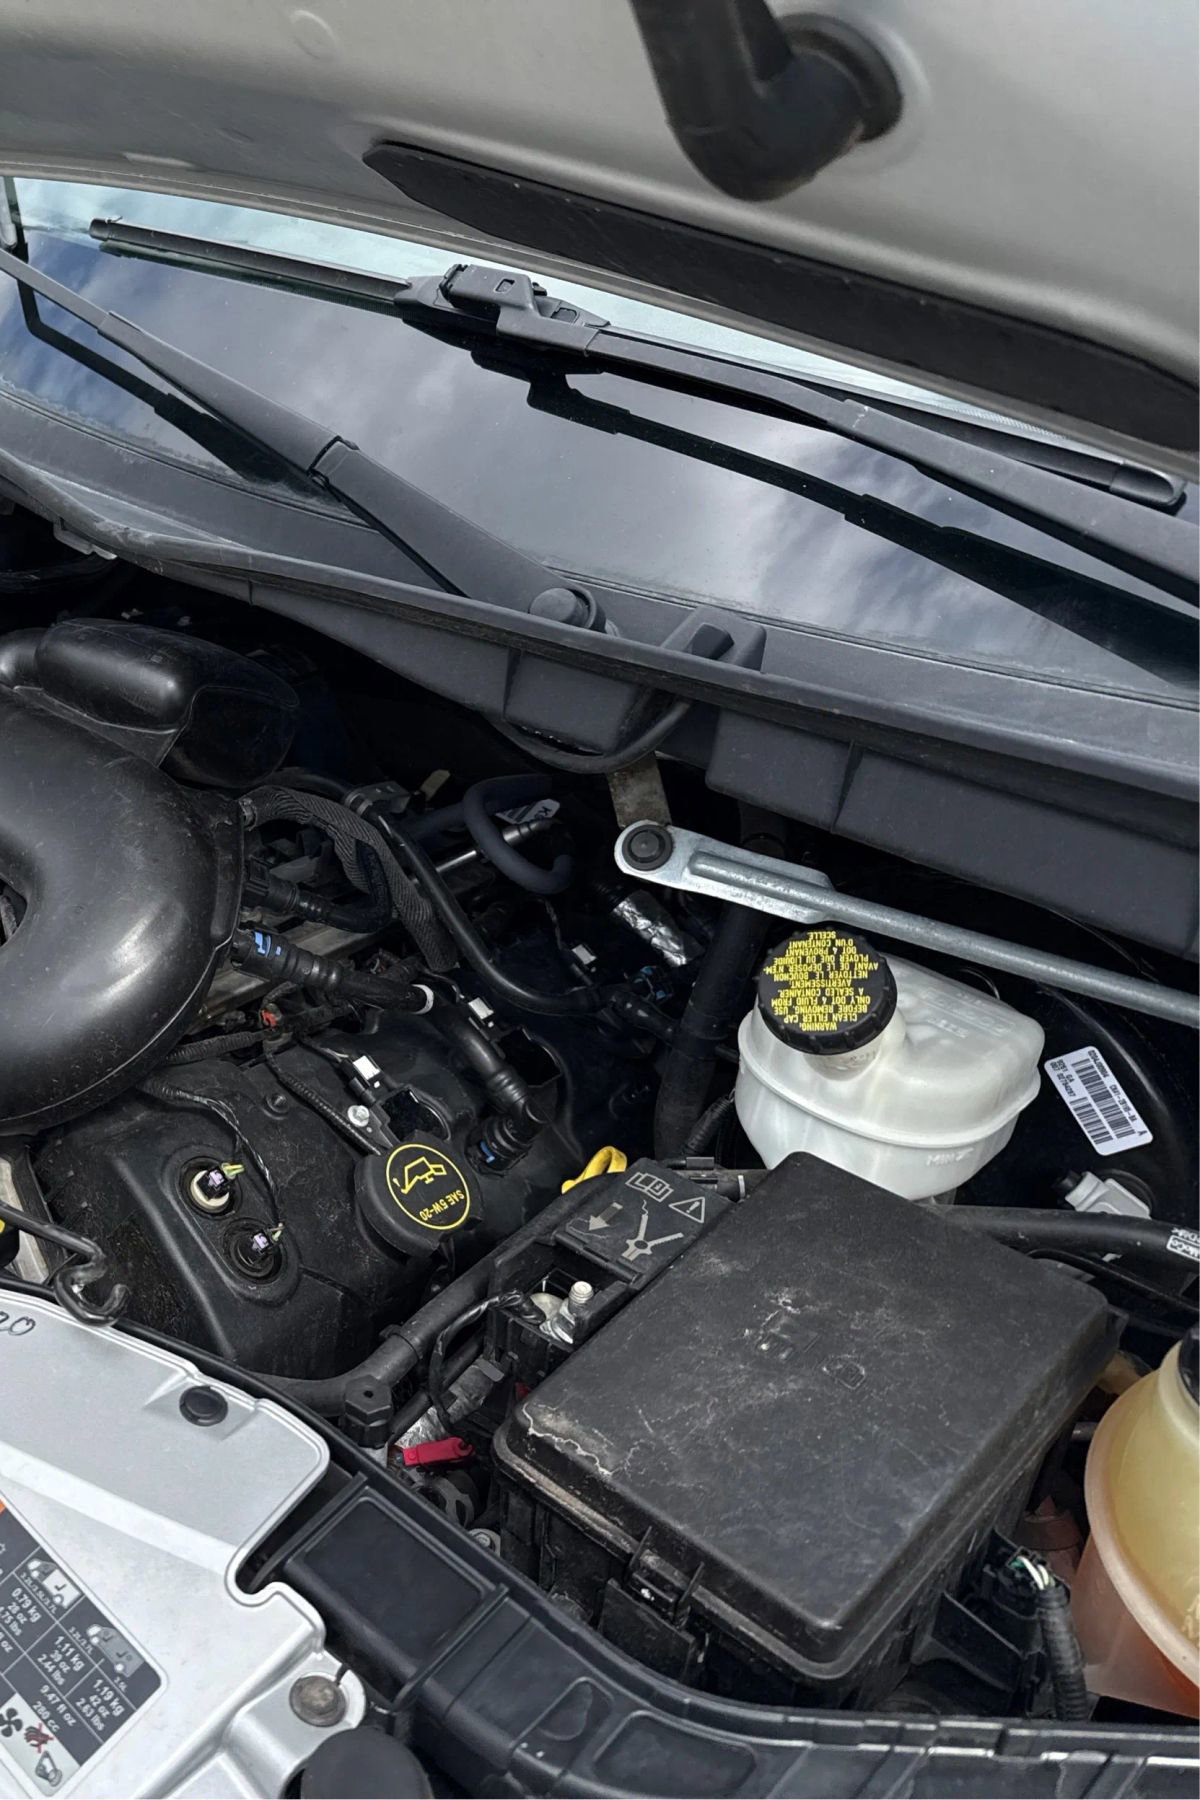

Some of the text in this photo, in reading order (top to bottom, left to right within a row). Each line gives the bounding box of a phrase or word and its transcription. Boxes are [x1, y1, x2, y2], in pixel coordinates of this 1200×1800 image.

[789, 939, 831, 948] CONTENANT
[842, 946, 856, 954] DOT
[785, 947, 828, 956] PROVENANT
[774, 954, 868, 965] PLOYER QUE DU LIQUIDE
[854, 962, 878, 970] AVANT
[827, 963, 835, 971] LE
[774, 970, 868, 981] NETTOYER LE BOUCHON
[825, 988, 854, 996] SEALED
[771, 996, 870, 1007] ONLY DOT 4 FLUID FROM
[774, 1006, 788, 1015] USE
[838, 1005, 867, 1013] BEFORE
[784, 1013, 857, 1023] CLEAN FILLER CAP
[419, 1189, 465, 1221] SAE 5W-20
[11, 1586, 42, 1623] 0.79 kg
[7, 1601, 27, 1624] 28 oz
[8, 1621, 22, 1636] lbs
[0, 1639, 13, 1652] oz
[53, 1634, 86, 1672] 1.11 kg
[49, 1649, 71, 1673] 39 oz
[37, 1652, 66, 1685] 2.44 lbs
[91, 1677, 126, 1717] 1.19 kg
[39, 1684, 60, 1706] 9.47
[62, 1712, 76, 1726] oz
[87, 1692, 109, 1718] 42 oz
[32, 1700, 60, 1732] 280 cc
[75, 1696, 106, 1731] 2.63 lbs
